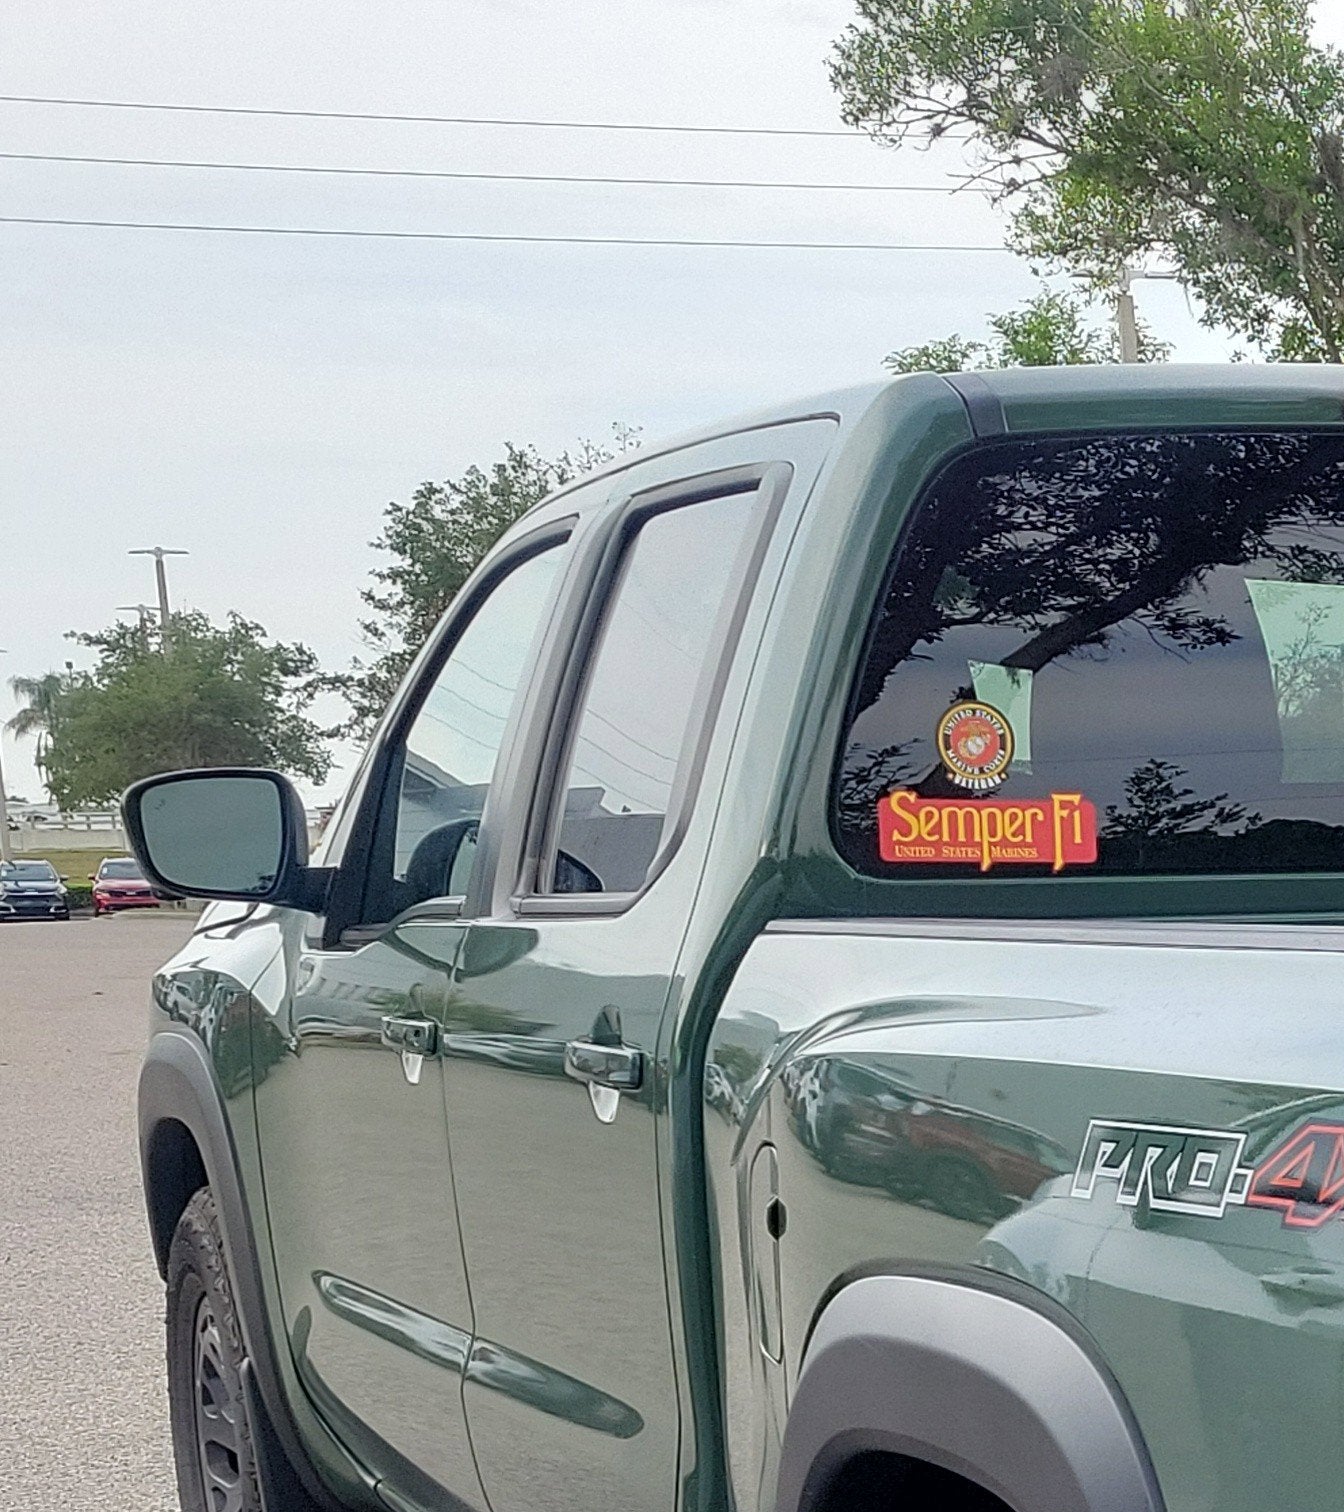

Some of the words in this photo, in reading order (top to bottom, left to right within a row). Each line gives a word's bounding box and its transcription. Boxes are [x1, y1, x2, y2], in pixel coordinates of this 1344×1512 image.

[943, 709, 974, 735] UNITED
[975, 709, 1005, 735] STATES
[890, 790, 1045, 872] Semper
[1051, 793, 1083, 873] Fi
[894, 845, 935, 858] UNITED
[941, 845, 981, 859] STATES
